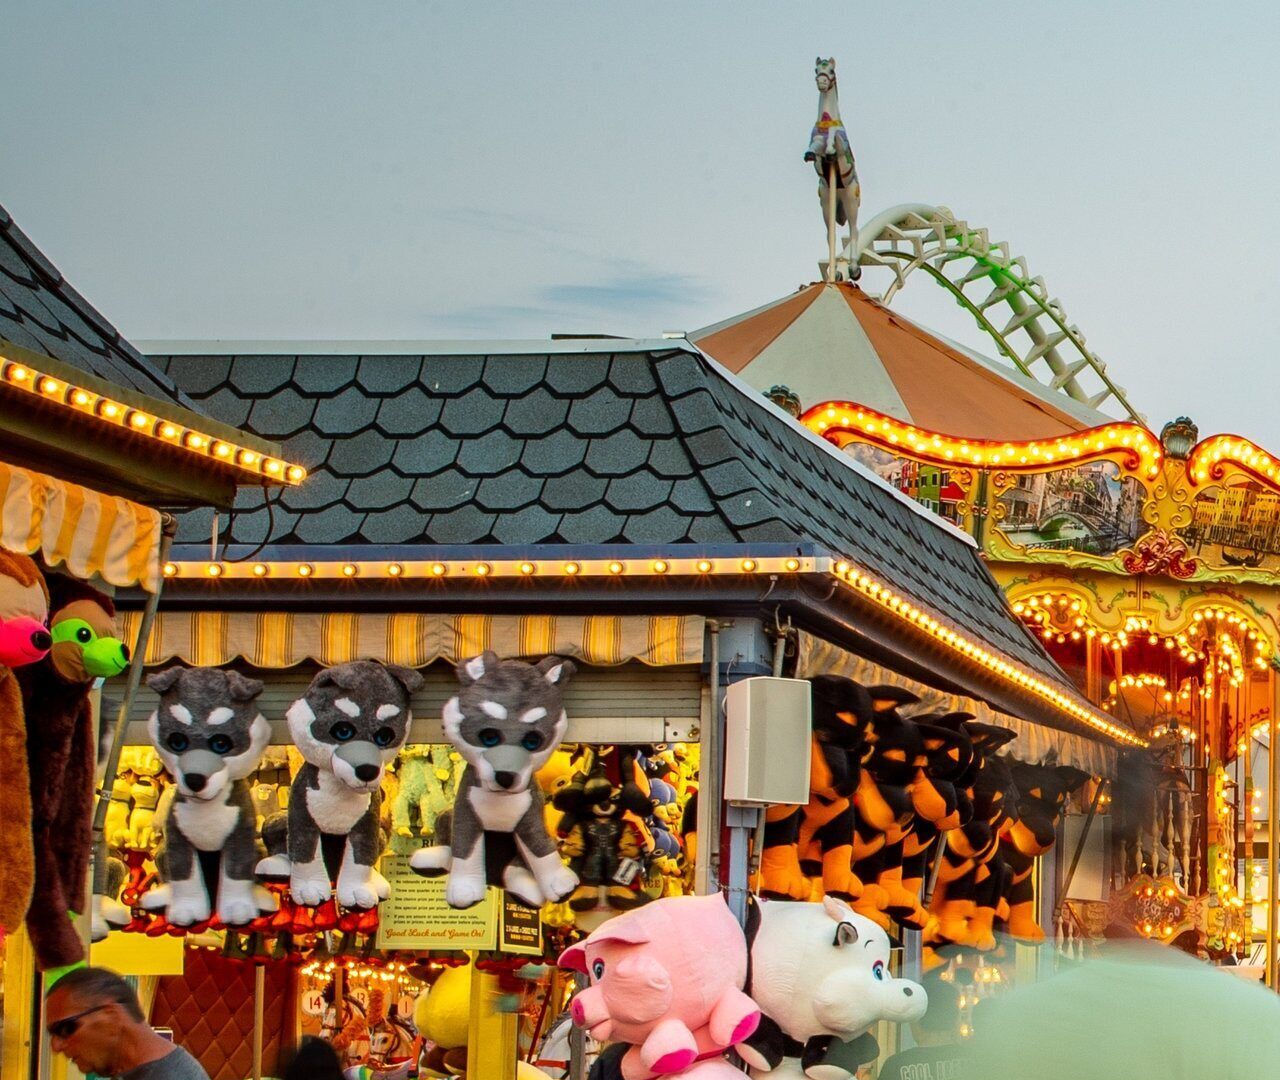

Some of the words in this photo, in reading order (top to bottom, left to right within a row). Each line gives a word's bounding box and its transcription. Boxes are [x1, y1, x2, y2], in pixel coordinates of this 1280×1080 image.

[385, 928, 407, 939] Good
[407, 928, 430, 937] Luck
[430, 929, 447, 937] and
[447, 929, 470, 940] Game
[309, 996, 321, 1010] 14
